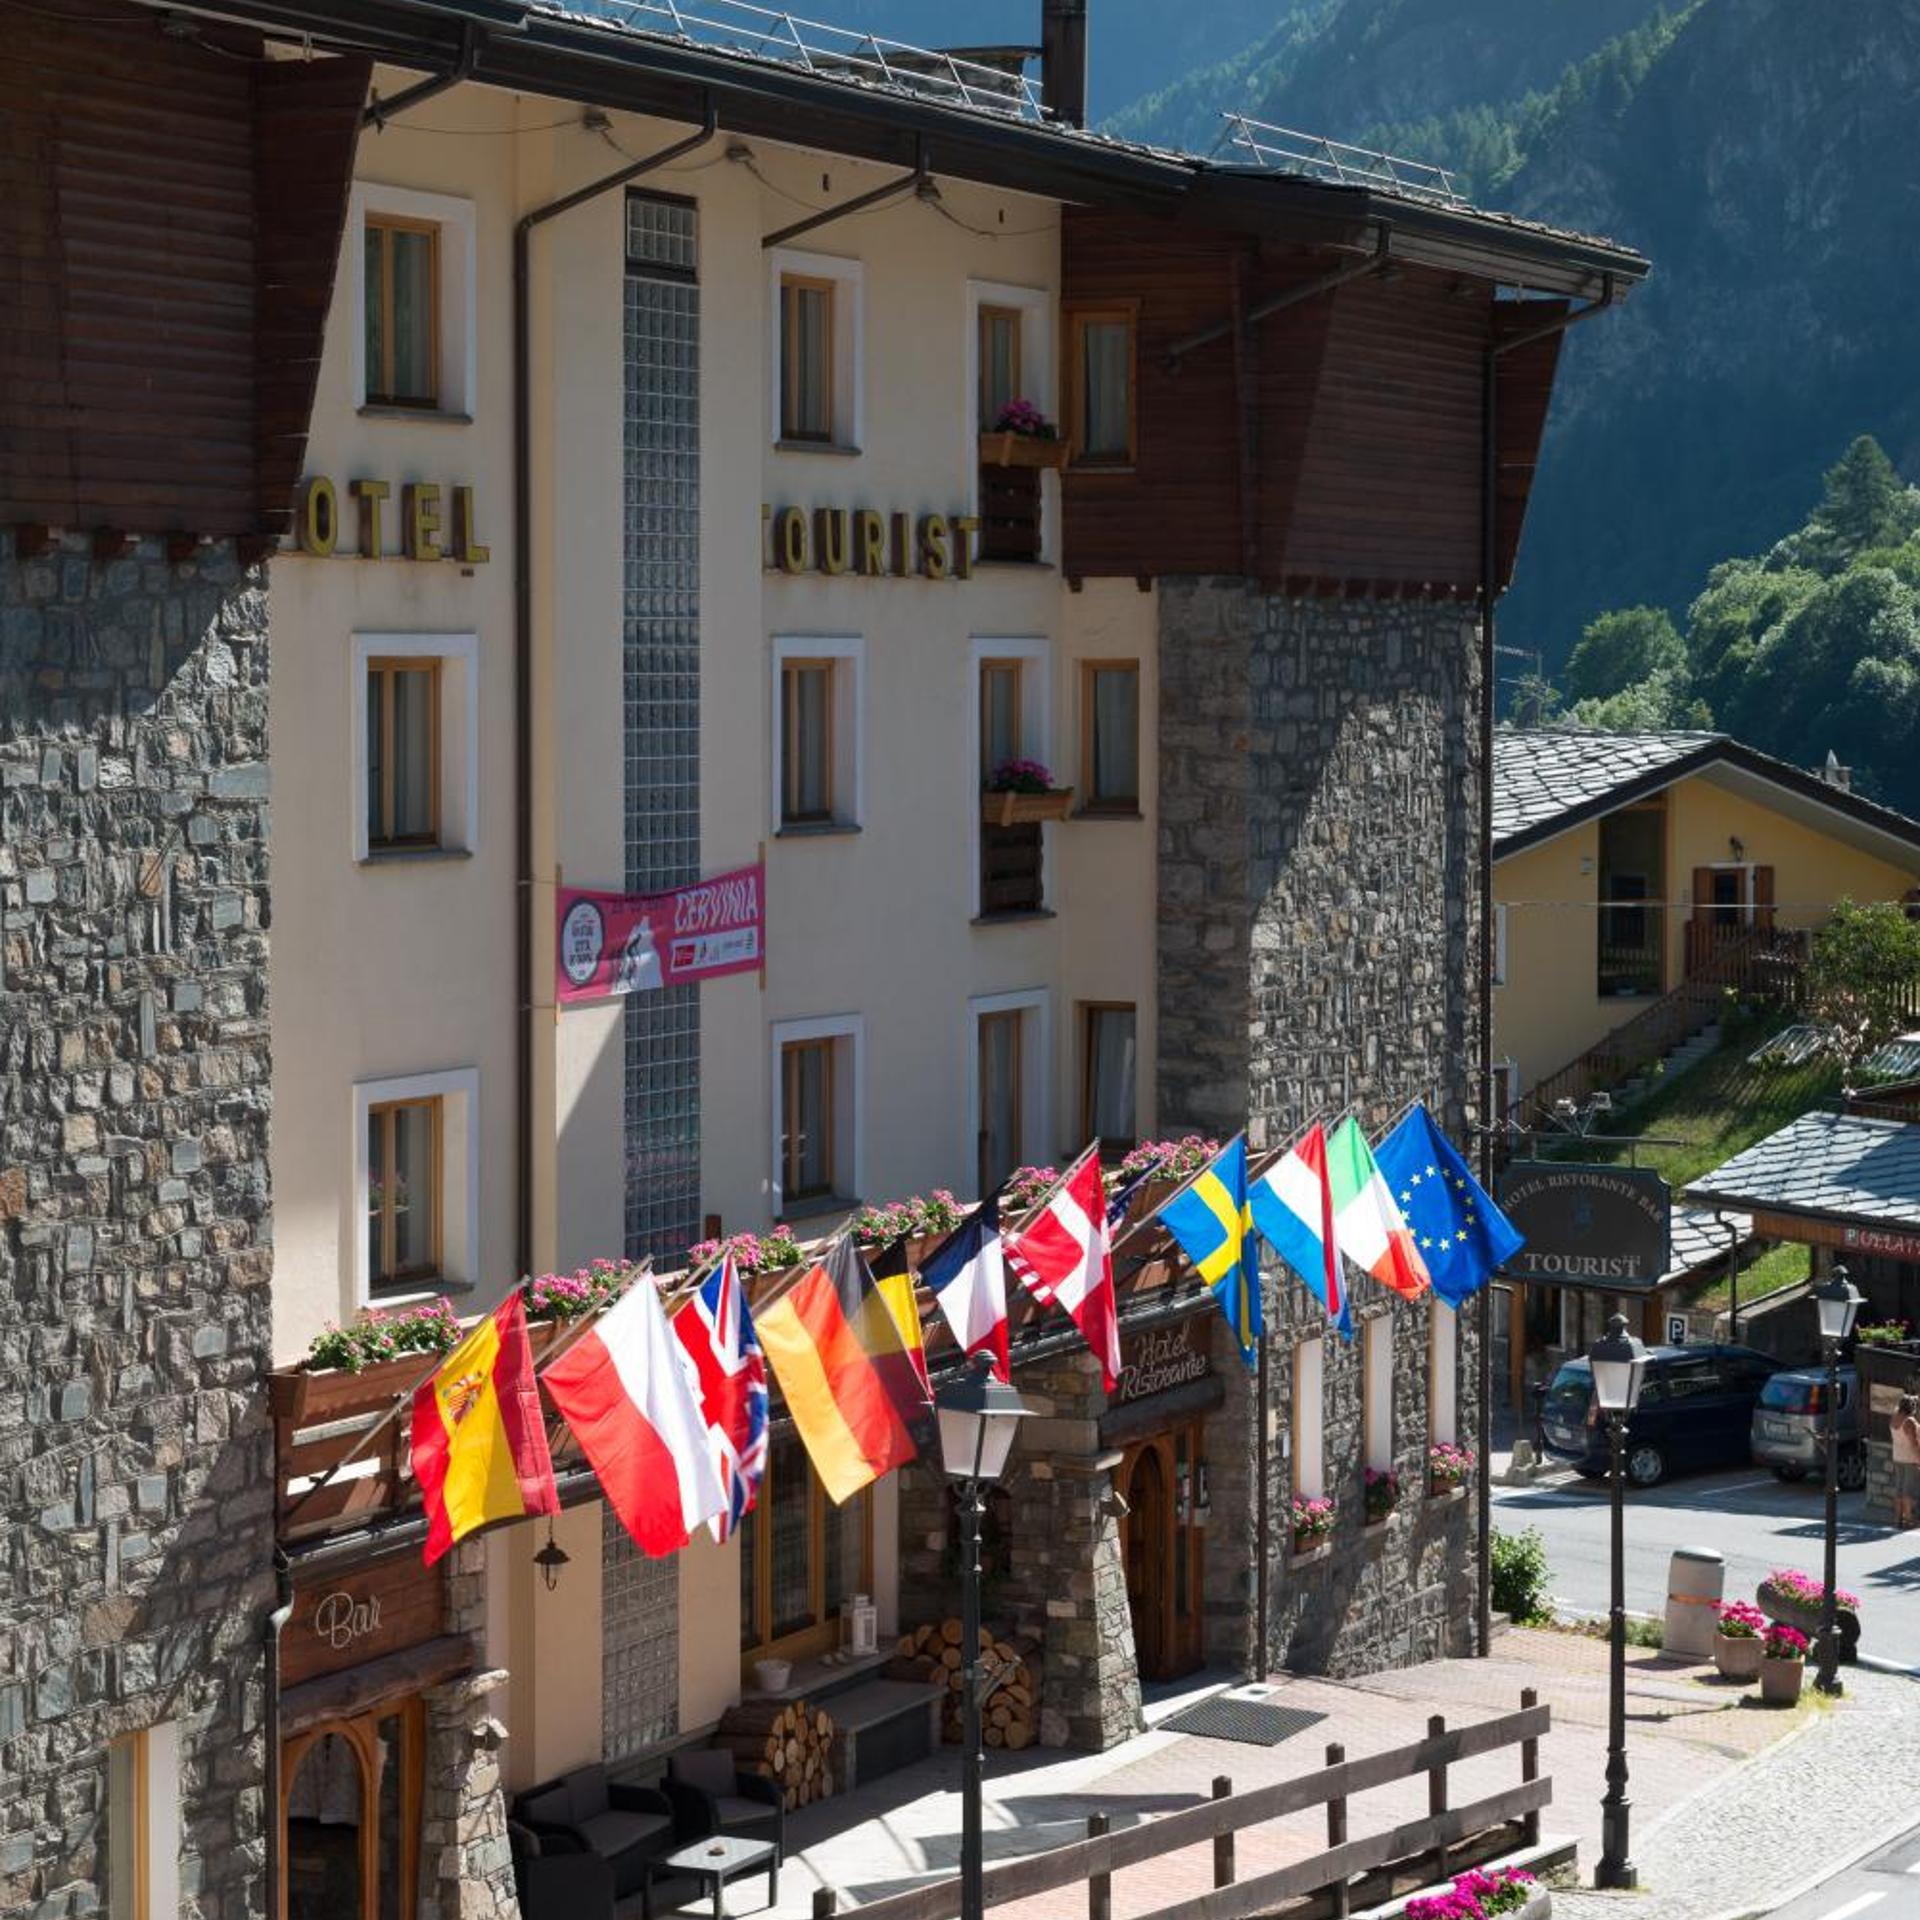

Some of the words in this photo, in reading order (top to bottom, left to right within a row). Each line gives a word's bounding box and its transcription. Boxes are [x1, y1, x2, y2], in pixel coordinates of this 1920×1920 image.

[299, 476, 490, 562] OTEL
[674, 874, 759, 933] CERVINIA
[1549, 1172, 1638, 1199] RISTORANTE
[1637, 1197, 1665, 1225] BAR
[1523, 1252, 1641, 1278] TOURIST
[1134, 1320, 1190, 1367] Hotel
[1671, 1320, 1683, 1339] P
[1119, 1352, 1206, 1401] Ristorante
[315, 1591, 383, 1649] Bar
